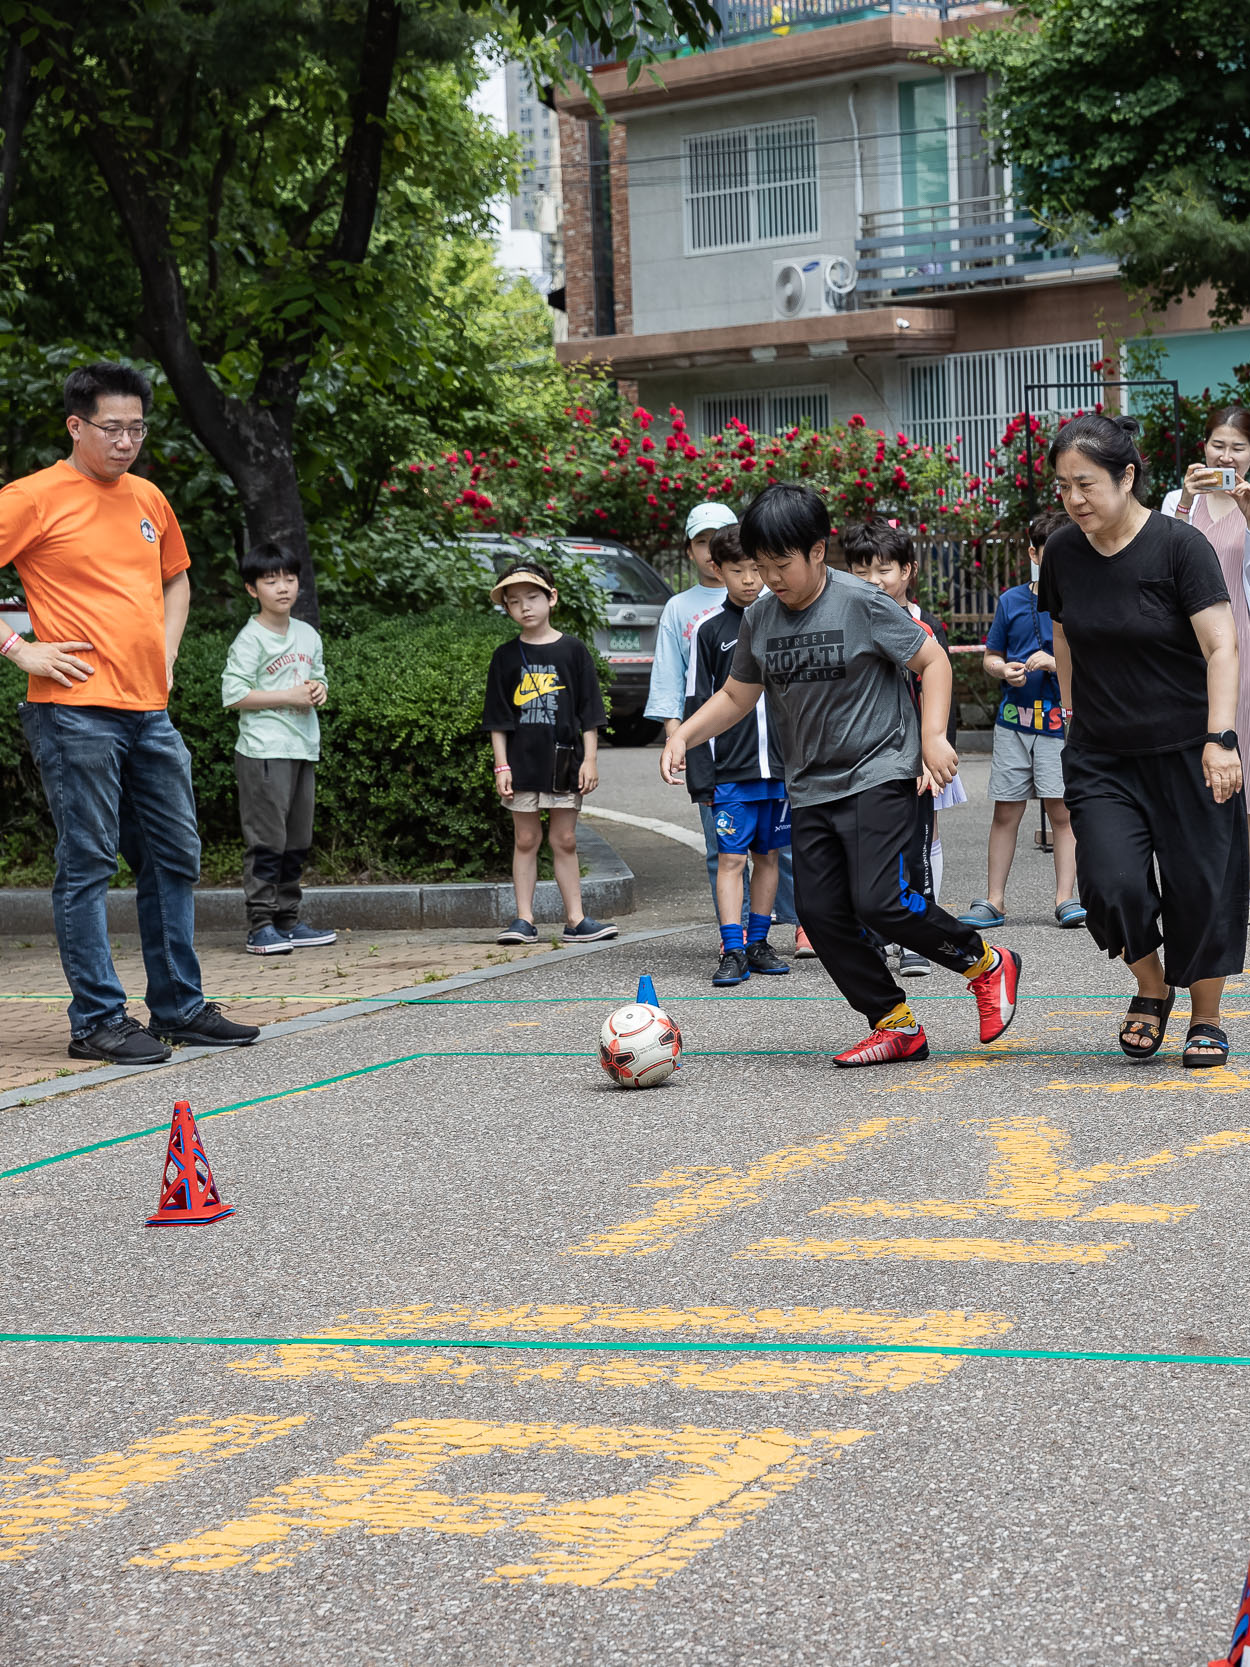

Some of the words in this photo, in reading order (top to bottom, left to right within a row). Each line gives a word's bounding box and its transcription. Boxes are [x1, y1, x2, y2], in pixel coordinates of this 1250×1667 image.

[777, 633, 828, 649] STREET
[266, 653, 296, 675] DIVIDE
[765, 645, 846, 673] MOLLTI
[520, 673, 558, 691] NIKE
